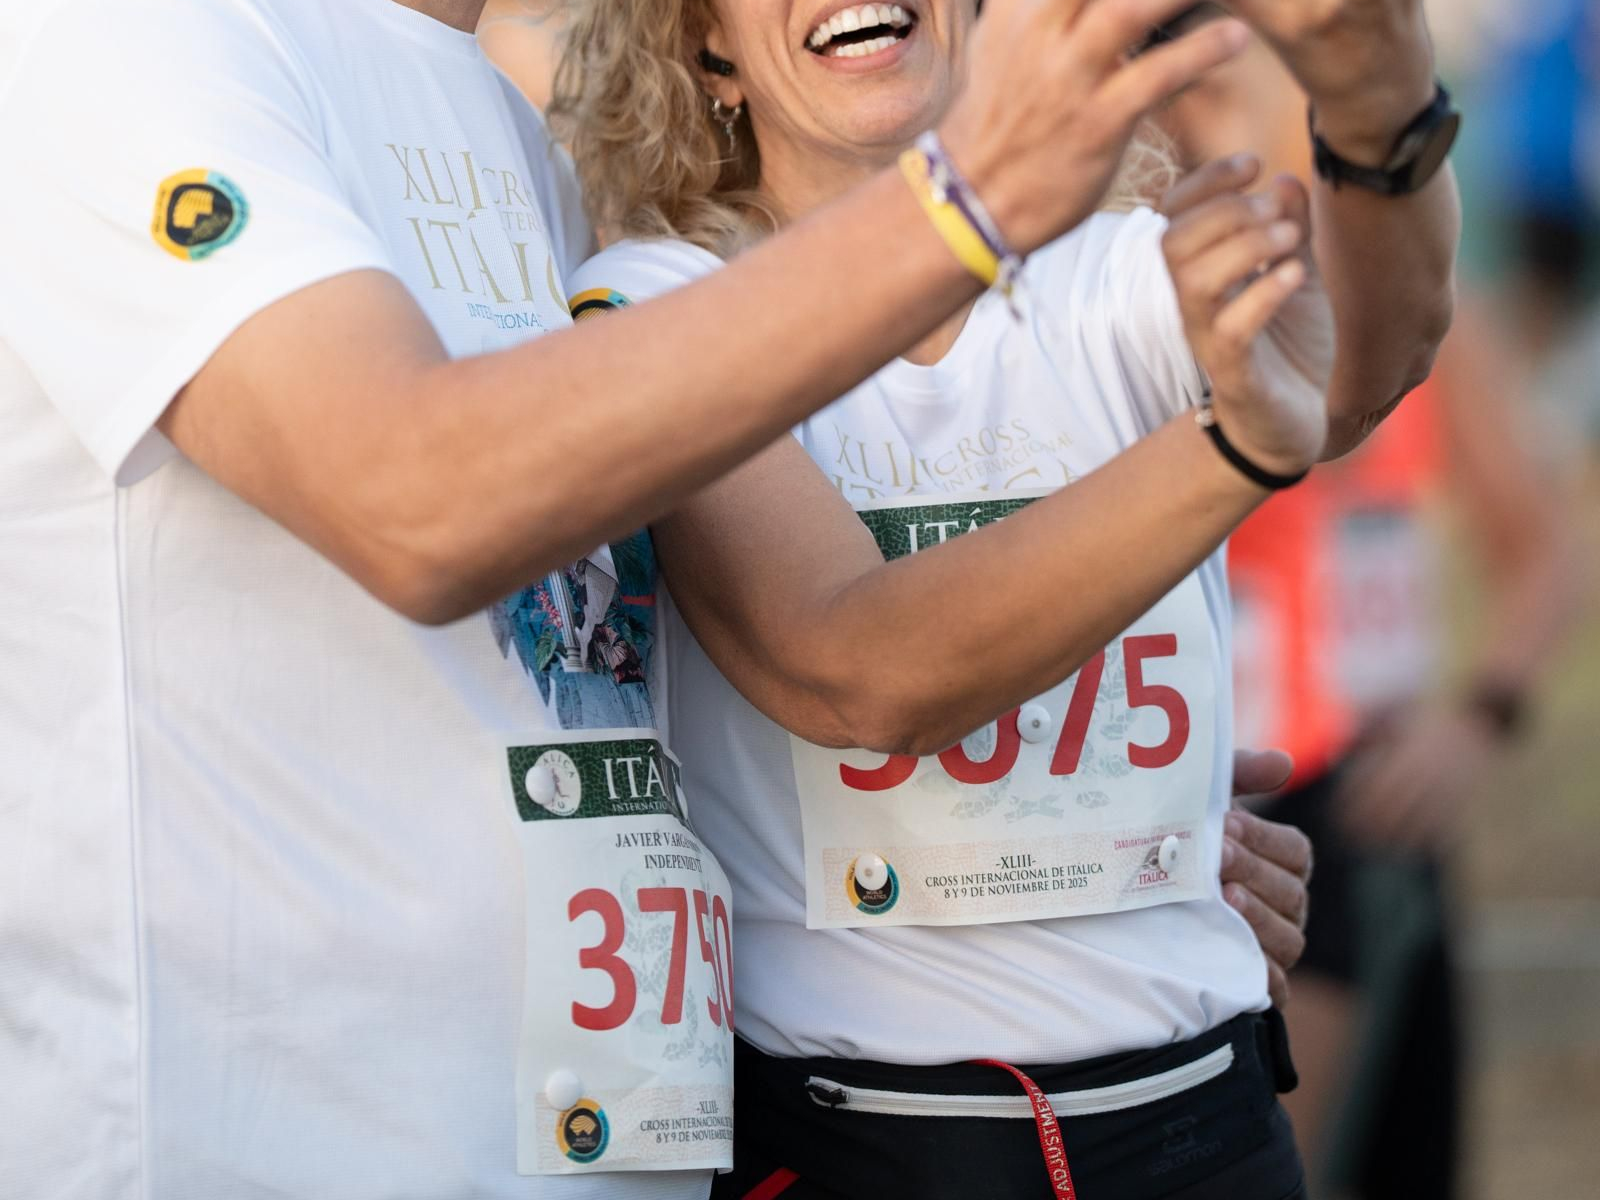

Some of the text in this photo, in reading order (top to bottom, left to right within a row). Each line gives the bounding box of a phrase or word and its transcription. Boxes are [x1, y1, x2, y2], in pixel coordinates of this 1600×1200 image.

[934, 418, 1031, 477] CROSS
[615, 832, 662, 848] JAVIER
[925, 874, 958, 888] CROSS
[961, 869, 1049, 886] INTERNACIONAL
[1051, 866, 1065, 878] DE
[944, 876, 1088, 899] 8 Y 9 DE NOVIEMBRE DE 2025
[640, 1119, 670, 1132] CROSS
[656, 1132, 662, 1144] 8
[663, 1132, 670, 1143] Y
[670, 1131, 676, 1142] 9
[678, 1131, 690, 1142] DE
